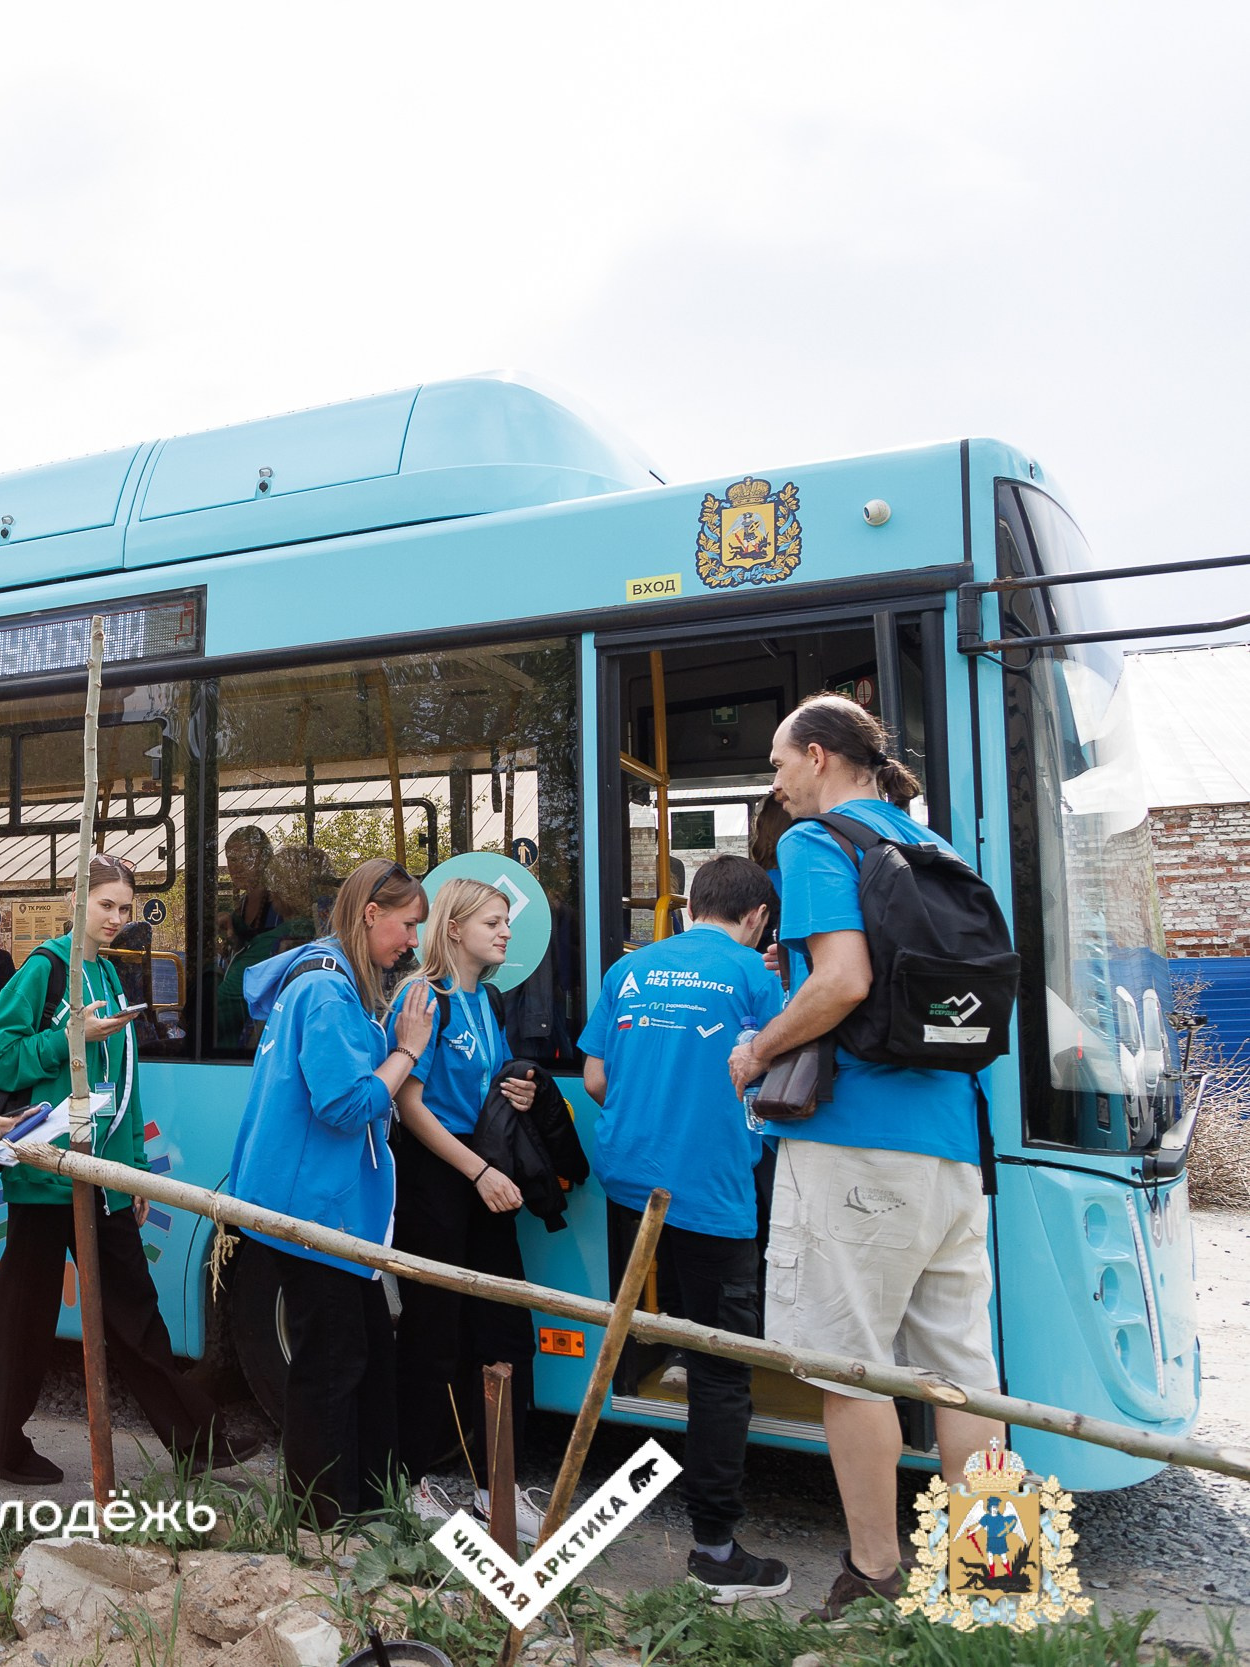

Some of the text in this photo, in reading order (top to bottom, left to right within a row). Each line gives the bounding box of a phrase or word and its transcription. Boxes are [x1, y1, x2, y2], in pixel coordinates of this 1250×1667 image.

[632, 579, 676, 596] ВХОД
[647, 969, 699, 979] АРКТИКА
[645, 977, 735, 995] ЛЁД ТРОНУЛСЯ
